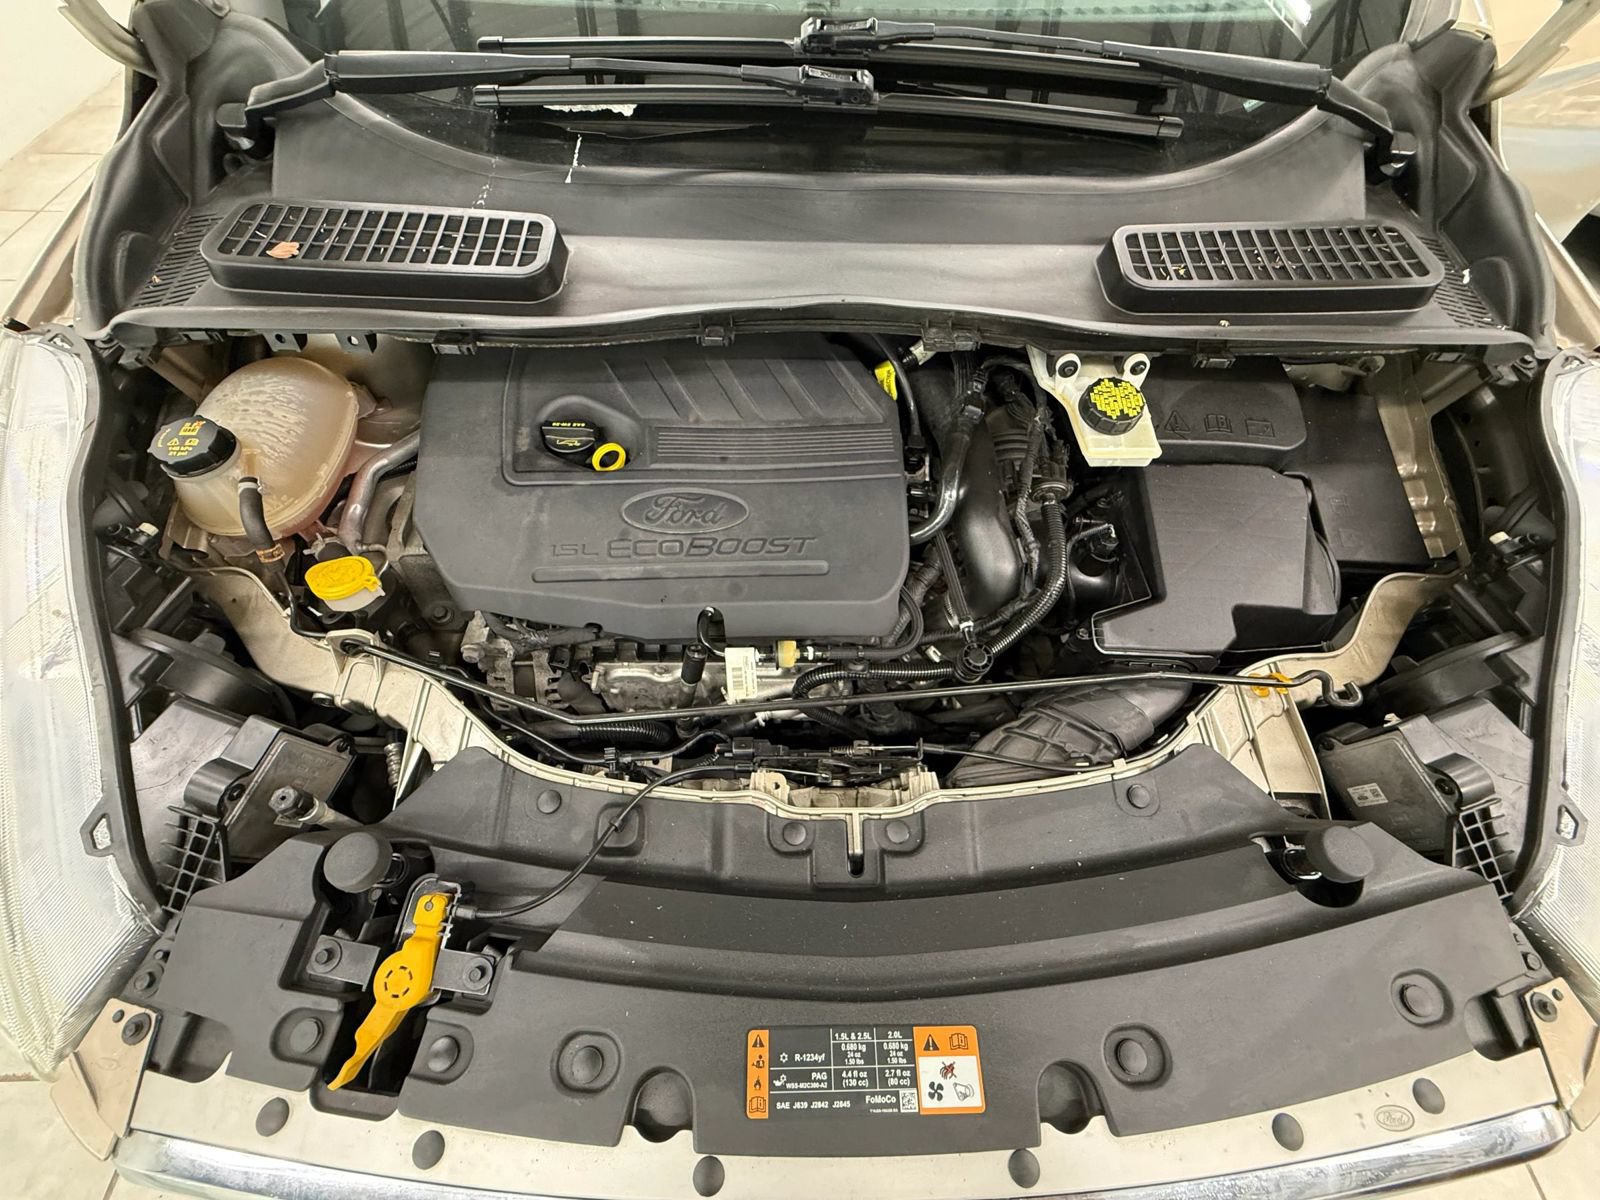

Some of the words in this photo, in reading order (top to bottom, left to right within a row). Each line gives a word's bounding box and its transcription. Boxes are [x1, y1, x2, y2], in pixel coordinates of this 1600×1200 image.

[645, 494, 728, 526] Ford
[607, 536, 817, 559] ECOBOOST
[835, 1032, 849, 1040] 1.5L
[850, 1032, 856, 1040] &
[857, 1031, 872, 1040] 2.5L
[887, 1031, 903, 1039] 2.0L
[858, 1043, 867, 1052] kg
[900, 1042, 909, 1051] kg
[794, 1052, 826, 1063] R-1234yf
[811, 1072, 828, 1080] PAG
[841, 1070, 852, 1078] 4.4
[853, 1070, 858, 1078] fl
[885, 1069, 895, 1077] 2.7
[896, 1069, 901, 1077] fl
[842, 1079, 857, 1088] (130
[857, 1078, 869, 1088] cc)
[888, 1078, 899, 1087] (80
[899, 1077, 911, 1087] cc)
[865, 1094, 897, 1104] FoMoCo
[776, 1101, 791, 1109] SAE
[793, 1101, 808, 1109] J639
